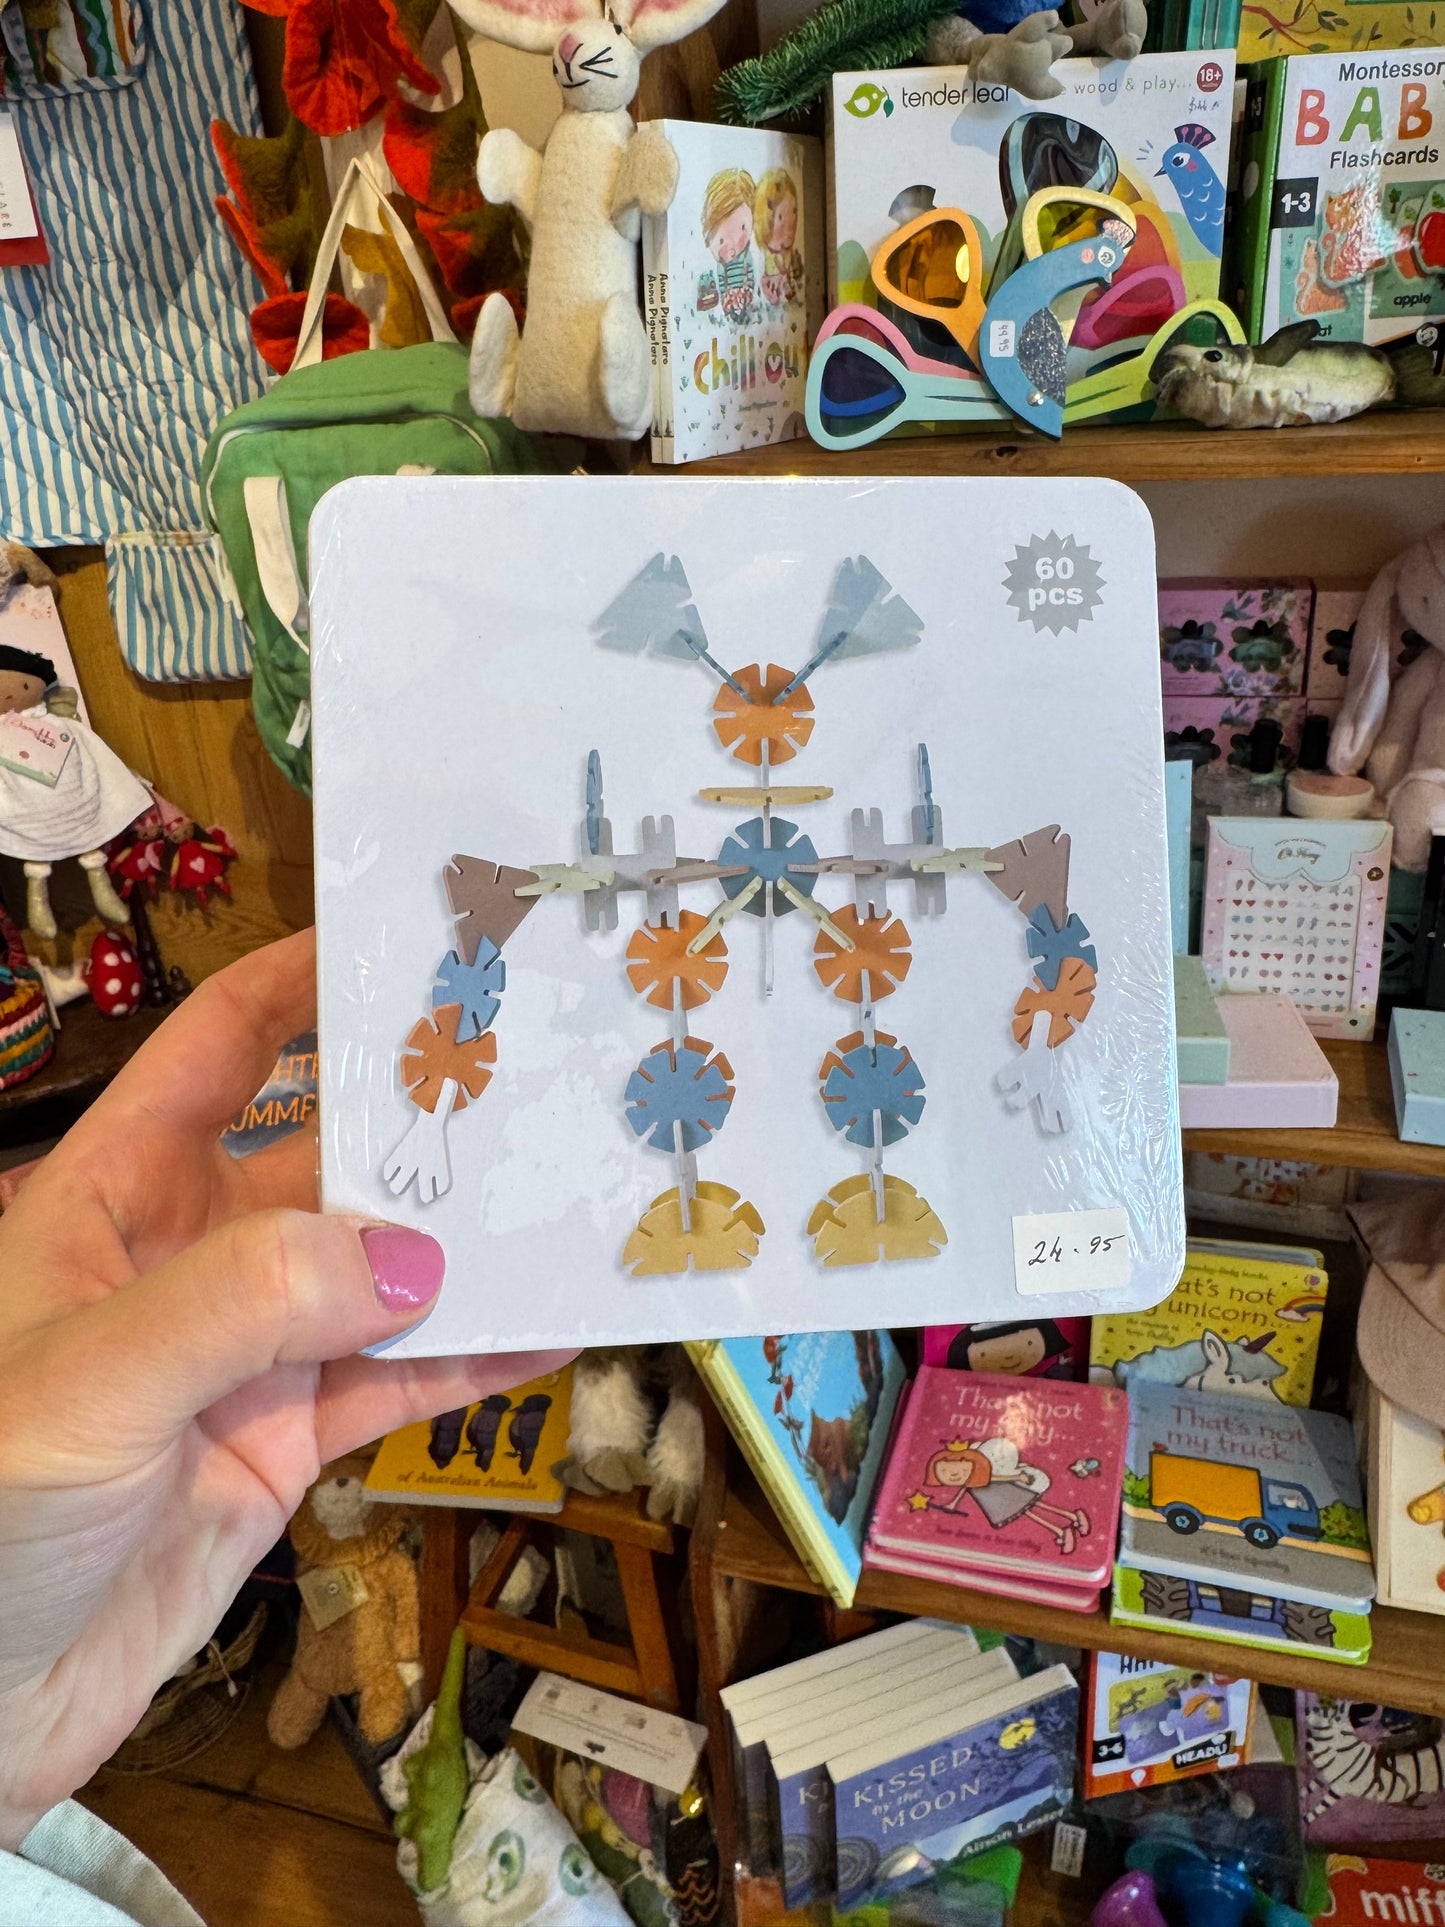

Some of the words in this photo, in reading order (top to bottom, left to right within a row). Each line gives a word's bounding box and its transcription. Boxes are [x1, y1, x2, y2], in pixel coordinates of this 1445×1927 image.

[1074, 79, 1118, 95] wood
[1125, 78, 1135, 91] &
[1200, 68, 1222, 82] 18+
[902, 83, 968, 108] tender
[1330, 145, 1439, 169] Flashcards
[1281, 191, 1311, 214] 1-3
[647, 274, 657, 305] Anna
[659, 273, 669, 304] Anna
[1393, 292, 1432, 309] apple
[646, 308, 660, 366] Pignataro
[658, 306, 671, 365] Pignataro
[1035, 556, 1075, 580] 60
[1028, 587, 1084, 612] pcs
[1229, 1287, 1277, 1306] not
[1036, 1402, 1083, 1421] not
[949, 1413, 990, 1437] my
[1172, 1404, 1250, 1436] That's
[1260, 1426, 1306, 1445] not
[1167, 1430, 1209, 1457] my
[854, 1746, 973, 1809] KISSED
[882, 1776, 981, 1835] MOON
